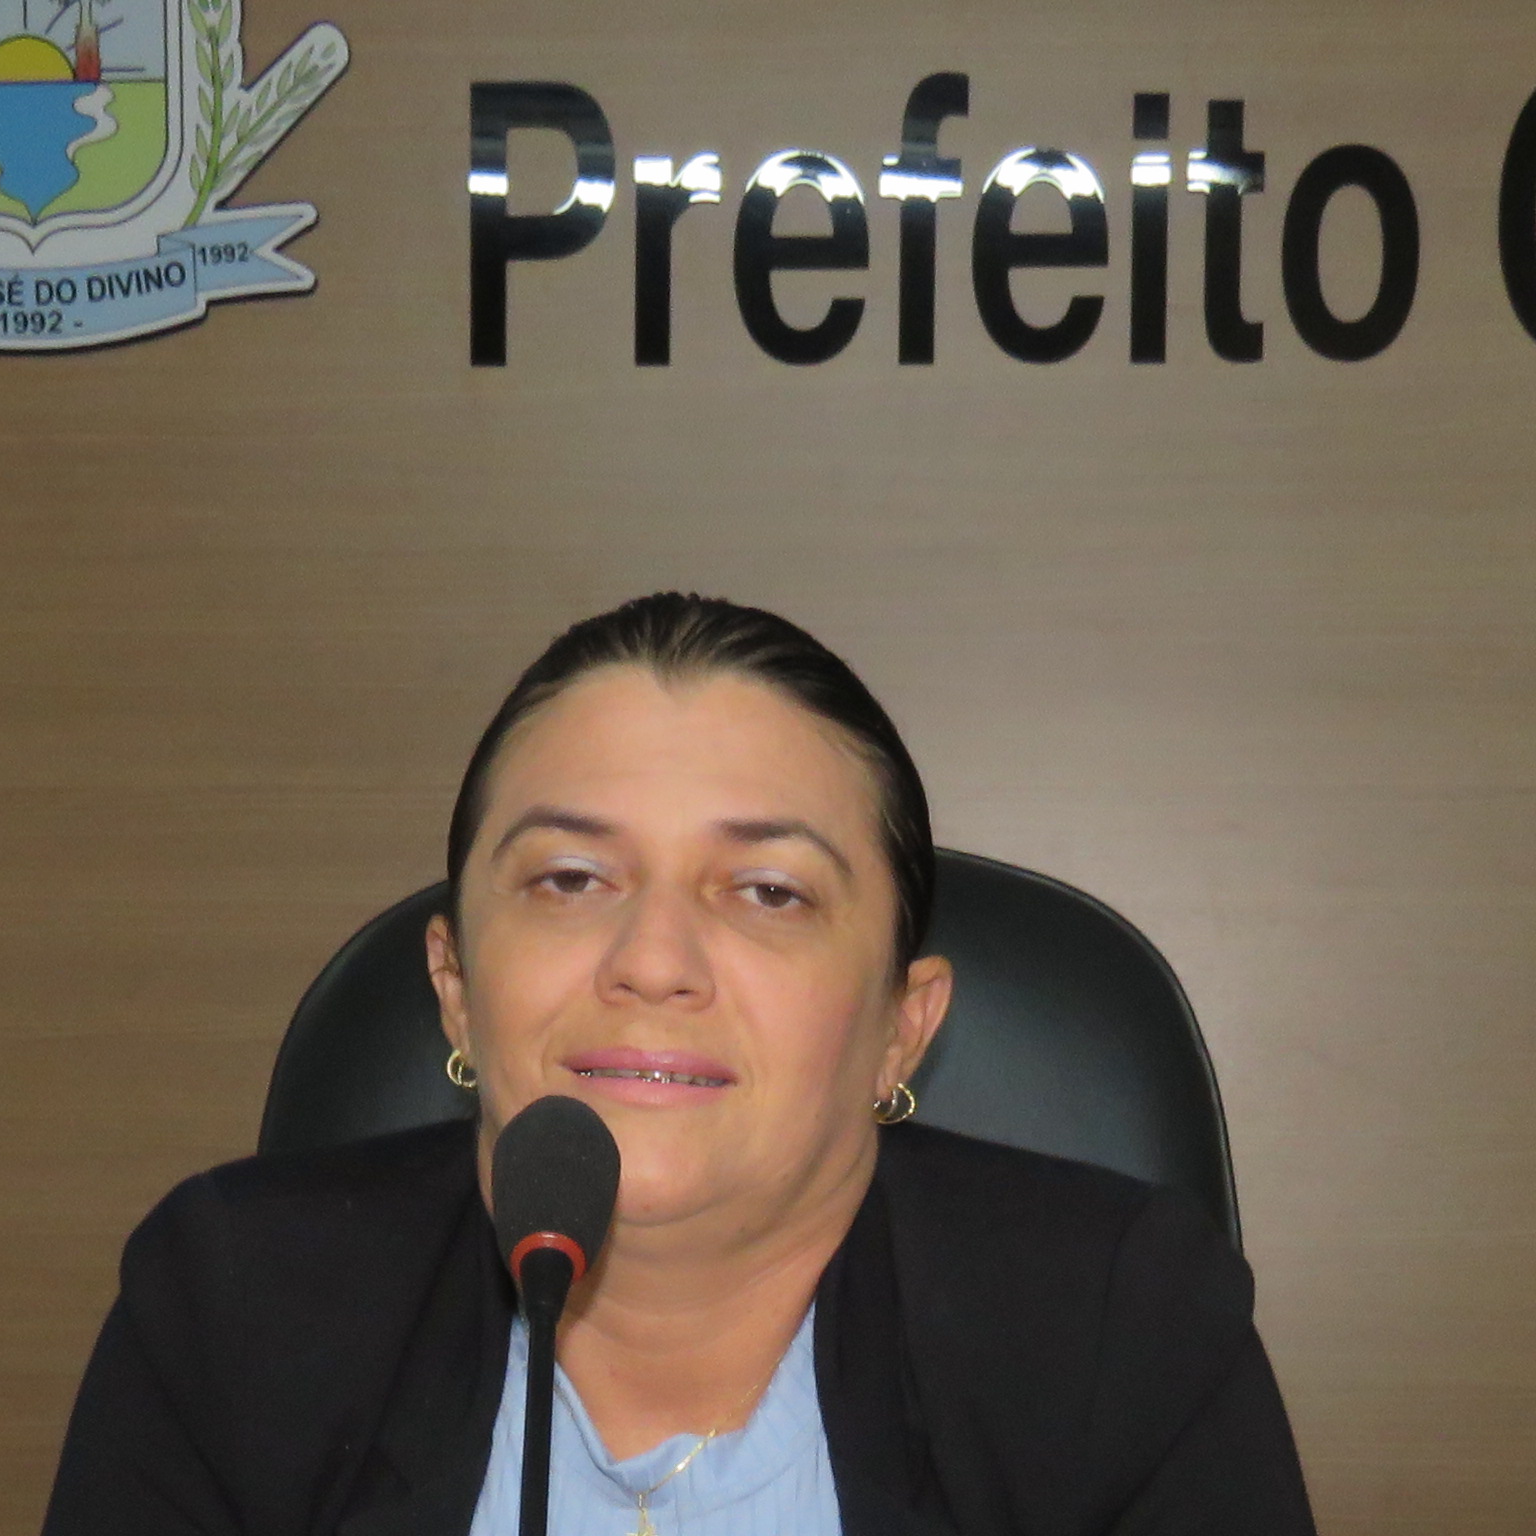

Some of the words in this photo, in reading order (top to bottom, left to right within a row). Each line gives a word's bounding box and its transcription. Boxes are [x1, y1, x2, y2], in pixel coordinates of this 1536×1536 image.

[470, 71, 1420, 366] Prefeito
[197, 242, 250, 266] 1992
[34, 278, 78, 305] DO
[87, 260, 187, 302] DIVINO
